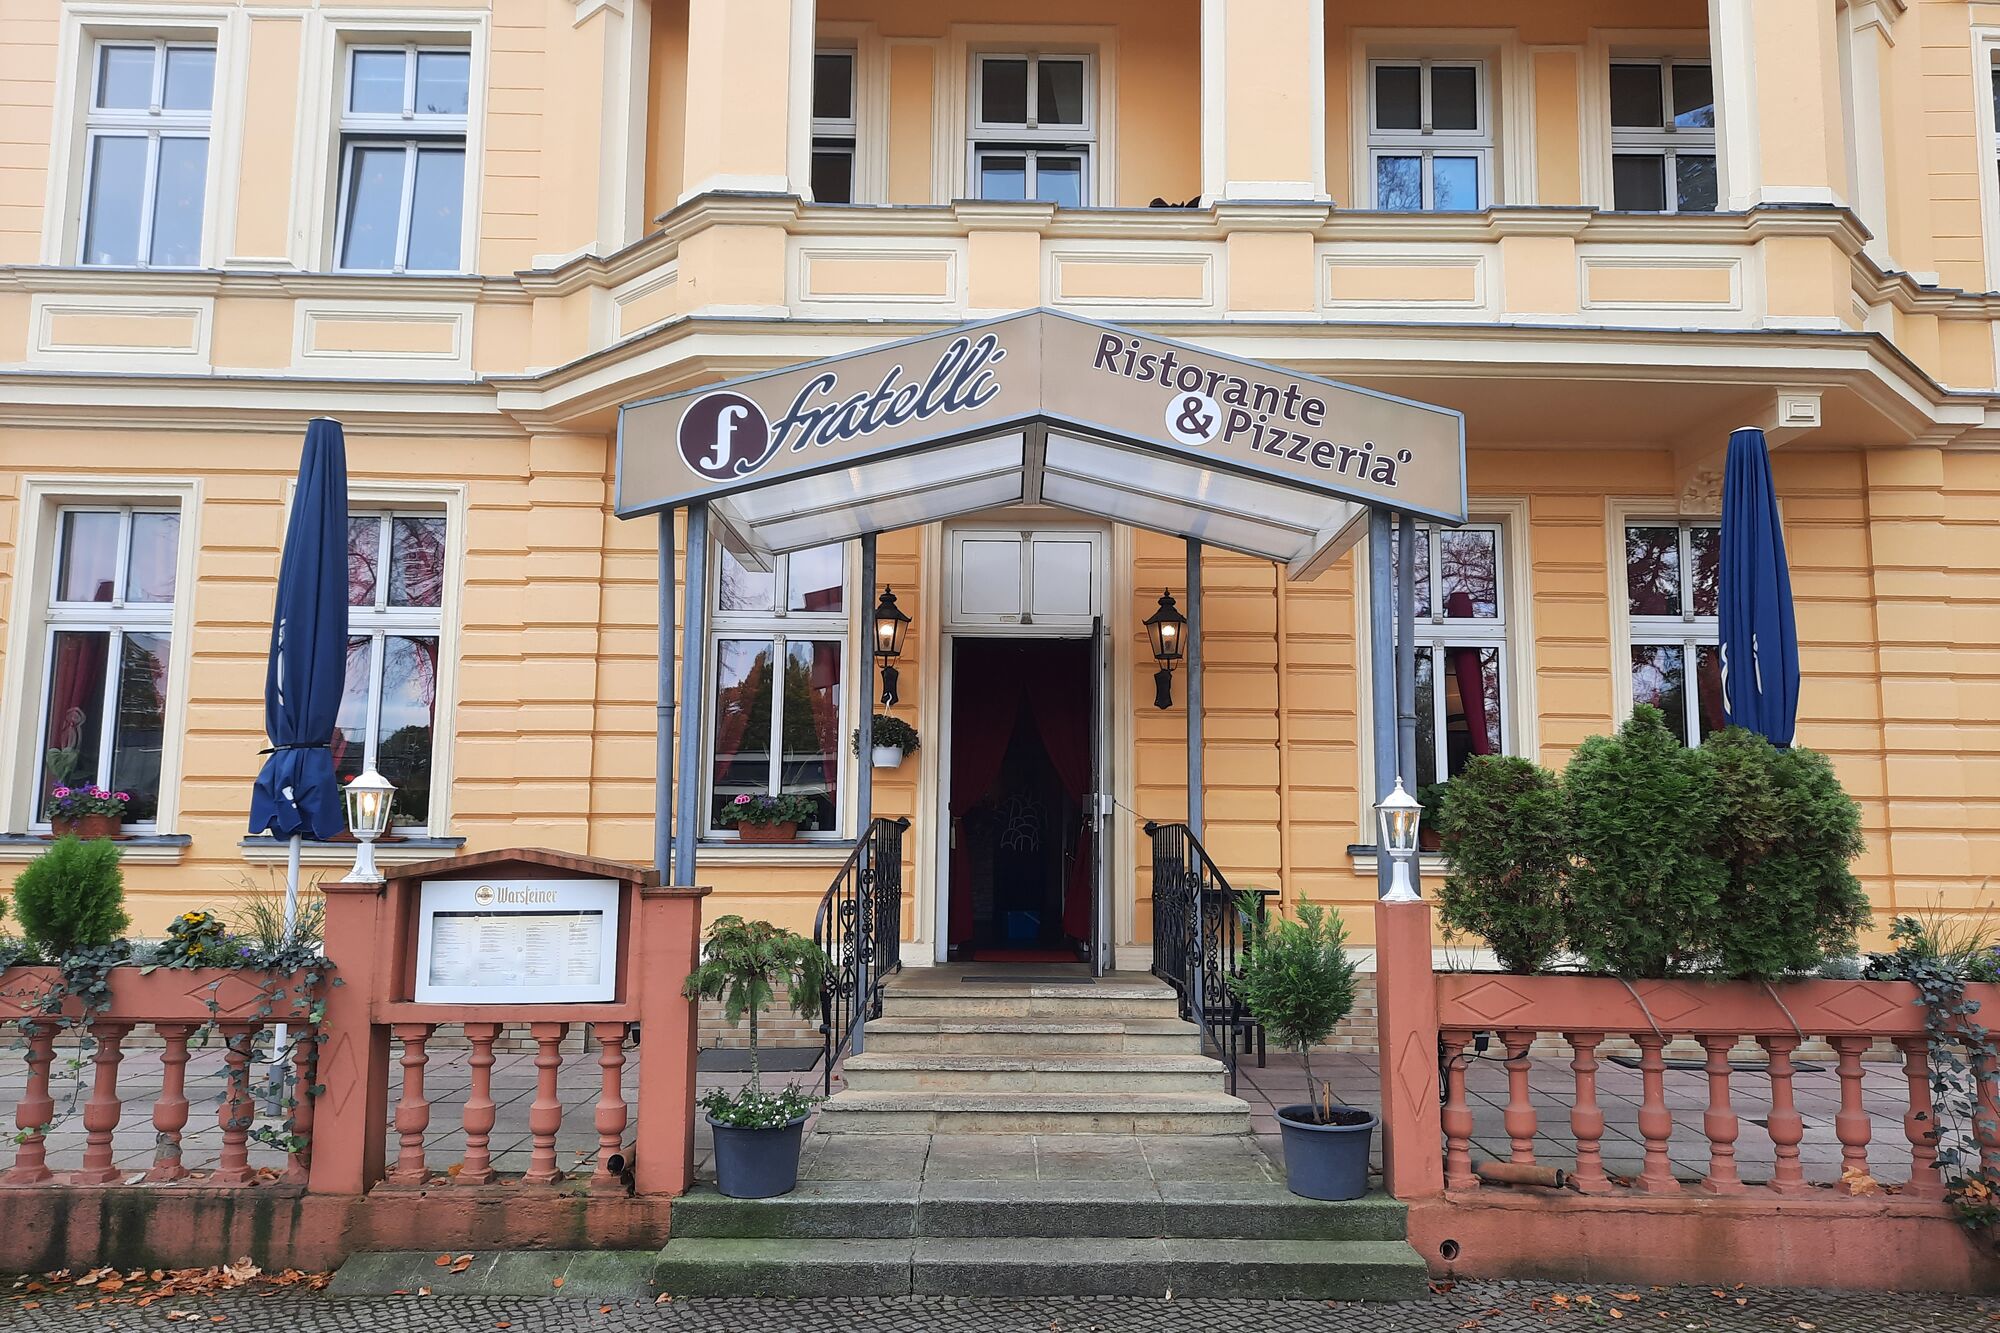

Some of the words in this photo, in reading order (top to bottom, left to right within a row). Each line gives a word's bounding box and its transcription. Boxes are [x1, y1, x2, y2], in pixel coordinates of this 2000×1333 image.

[734, 333, 1006, 475] fratelli
[1093, 332, 1327, 427] Ristorante
[1175, 395, 1214, 439] &
[1221, 407, 1398, 487] Pizzeria
[497, 886, 557, 905] Warsteiner
